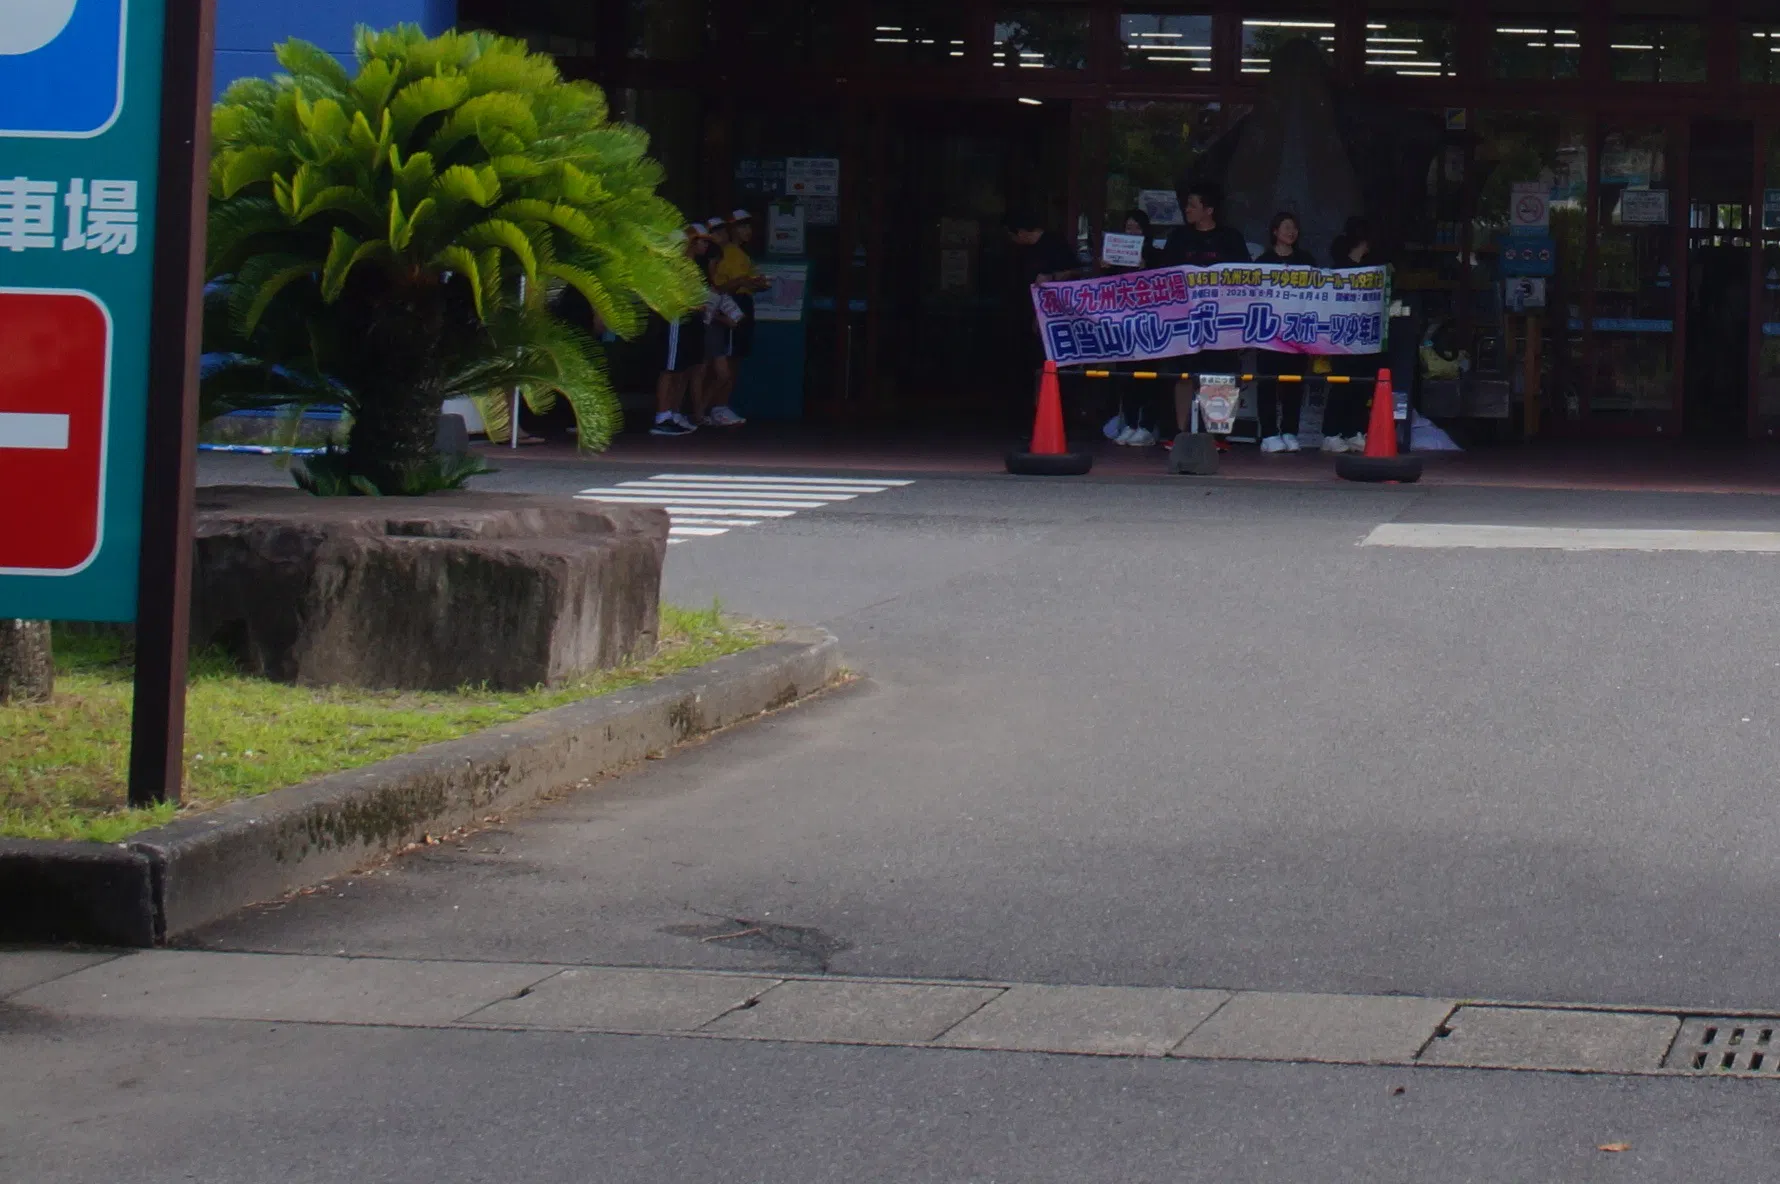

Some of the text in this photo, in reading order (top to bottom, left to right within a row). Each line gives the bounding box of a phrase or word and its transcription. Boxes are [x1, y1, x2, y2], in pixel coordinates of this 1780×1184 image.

[1048, 303, 1281, 360] 日当山バレーボール
